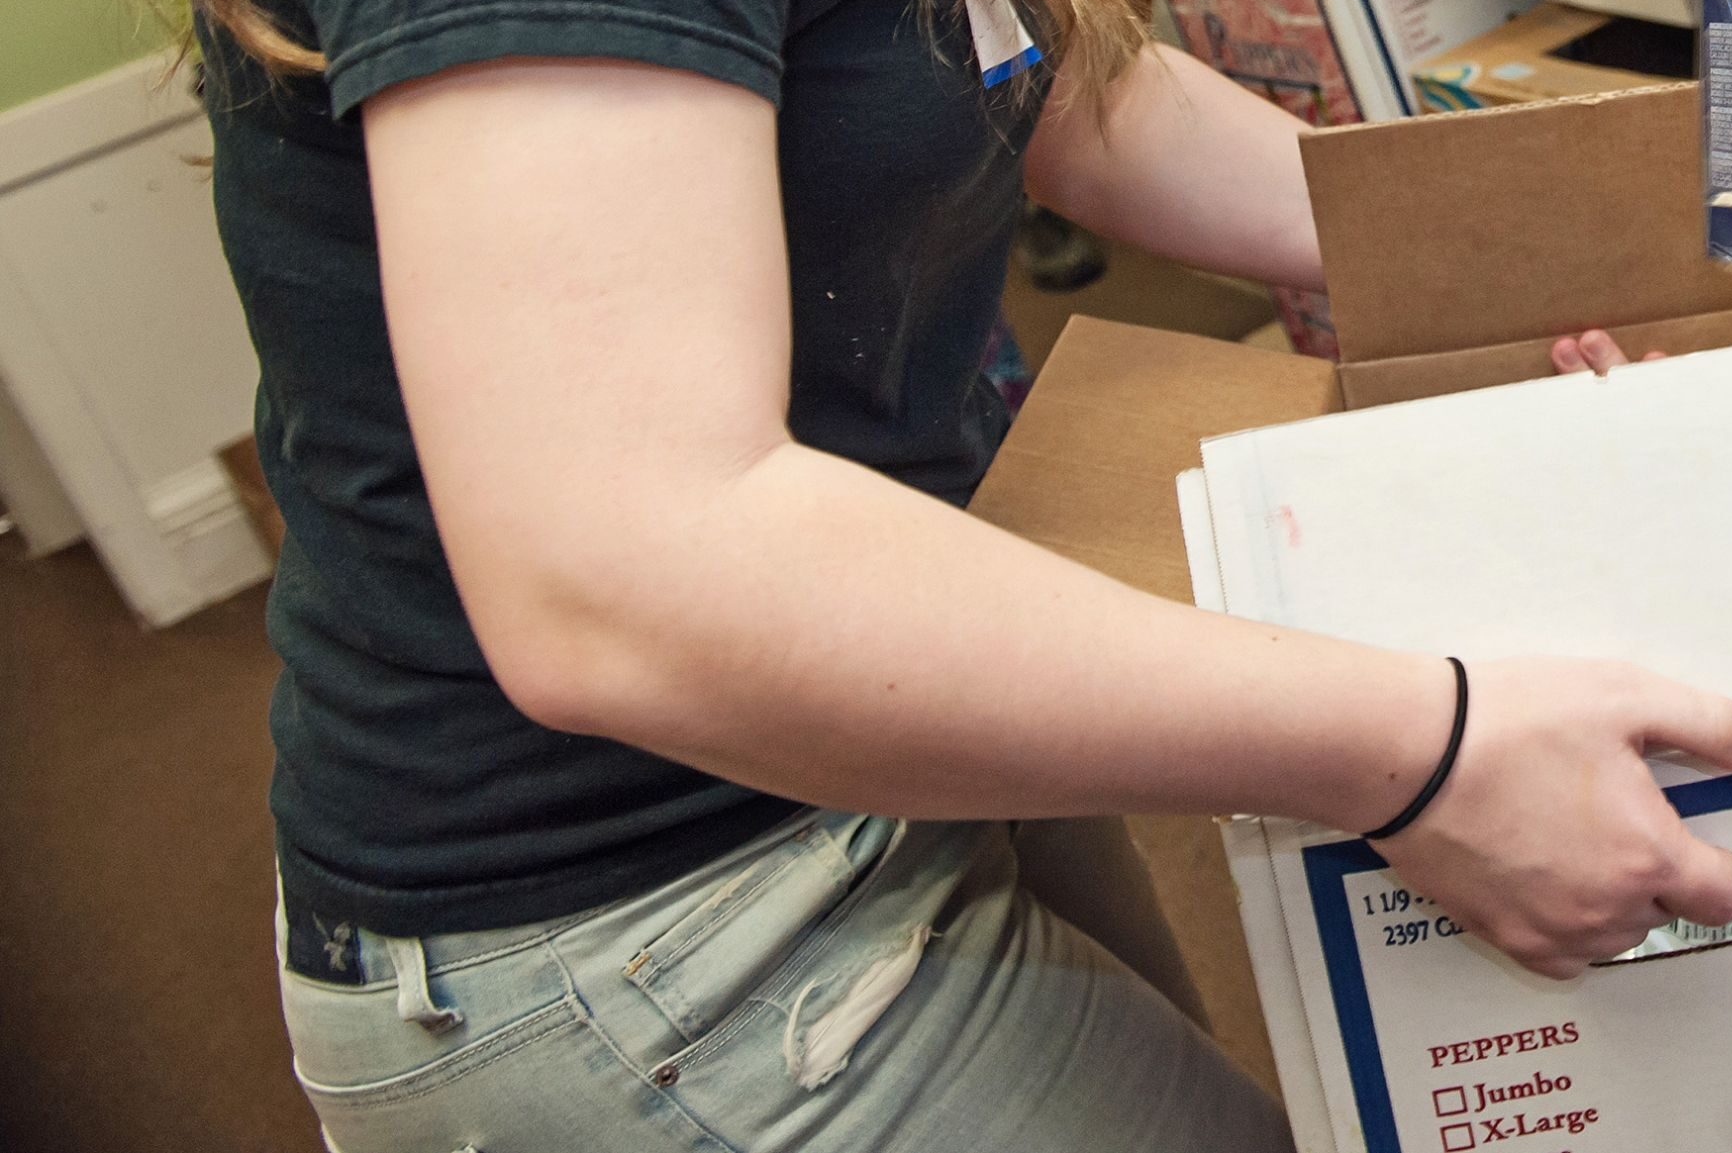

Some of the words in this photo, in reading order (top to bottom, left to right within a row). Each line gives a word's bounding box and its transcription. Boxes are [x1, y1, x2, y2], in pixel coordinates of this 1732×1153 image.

[1383, 920, 1429, 946] 2397
[1427, 1021, 1580, 1069] PEPPERS
[1473, 1071, 1572, 1113] Jumbo
[1479, 1107, 1600, 1144] X-Large
